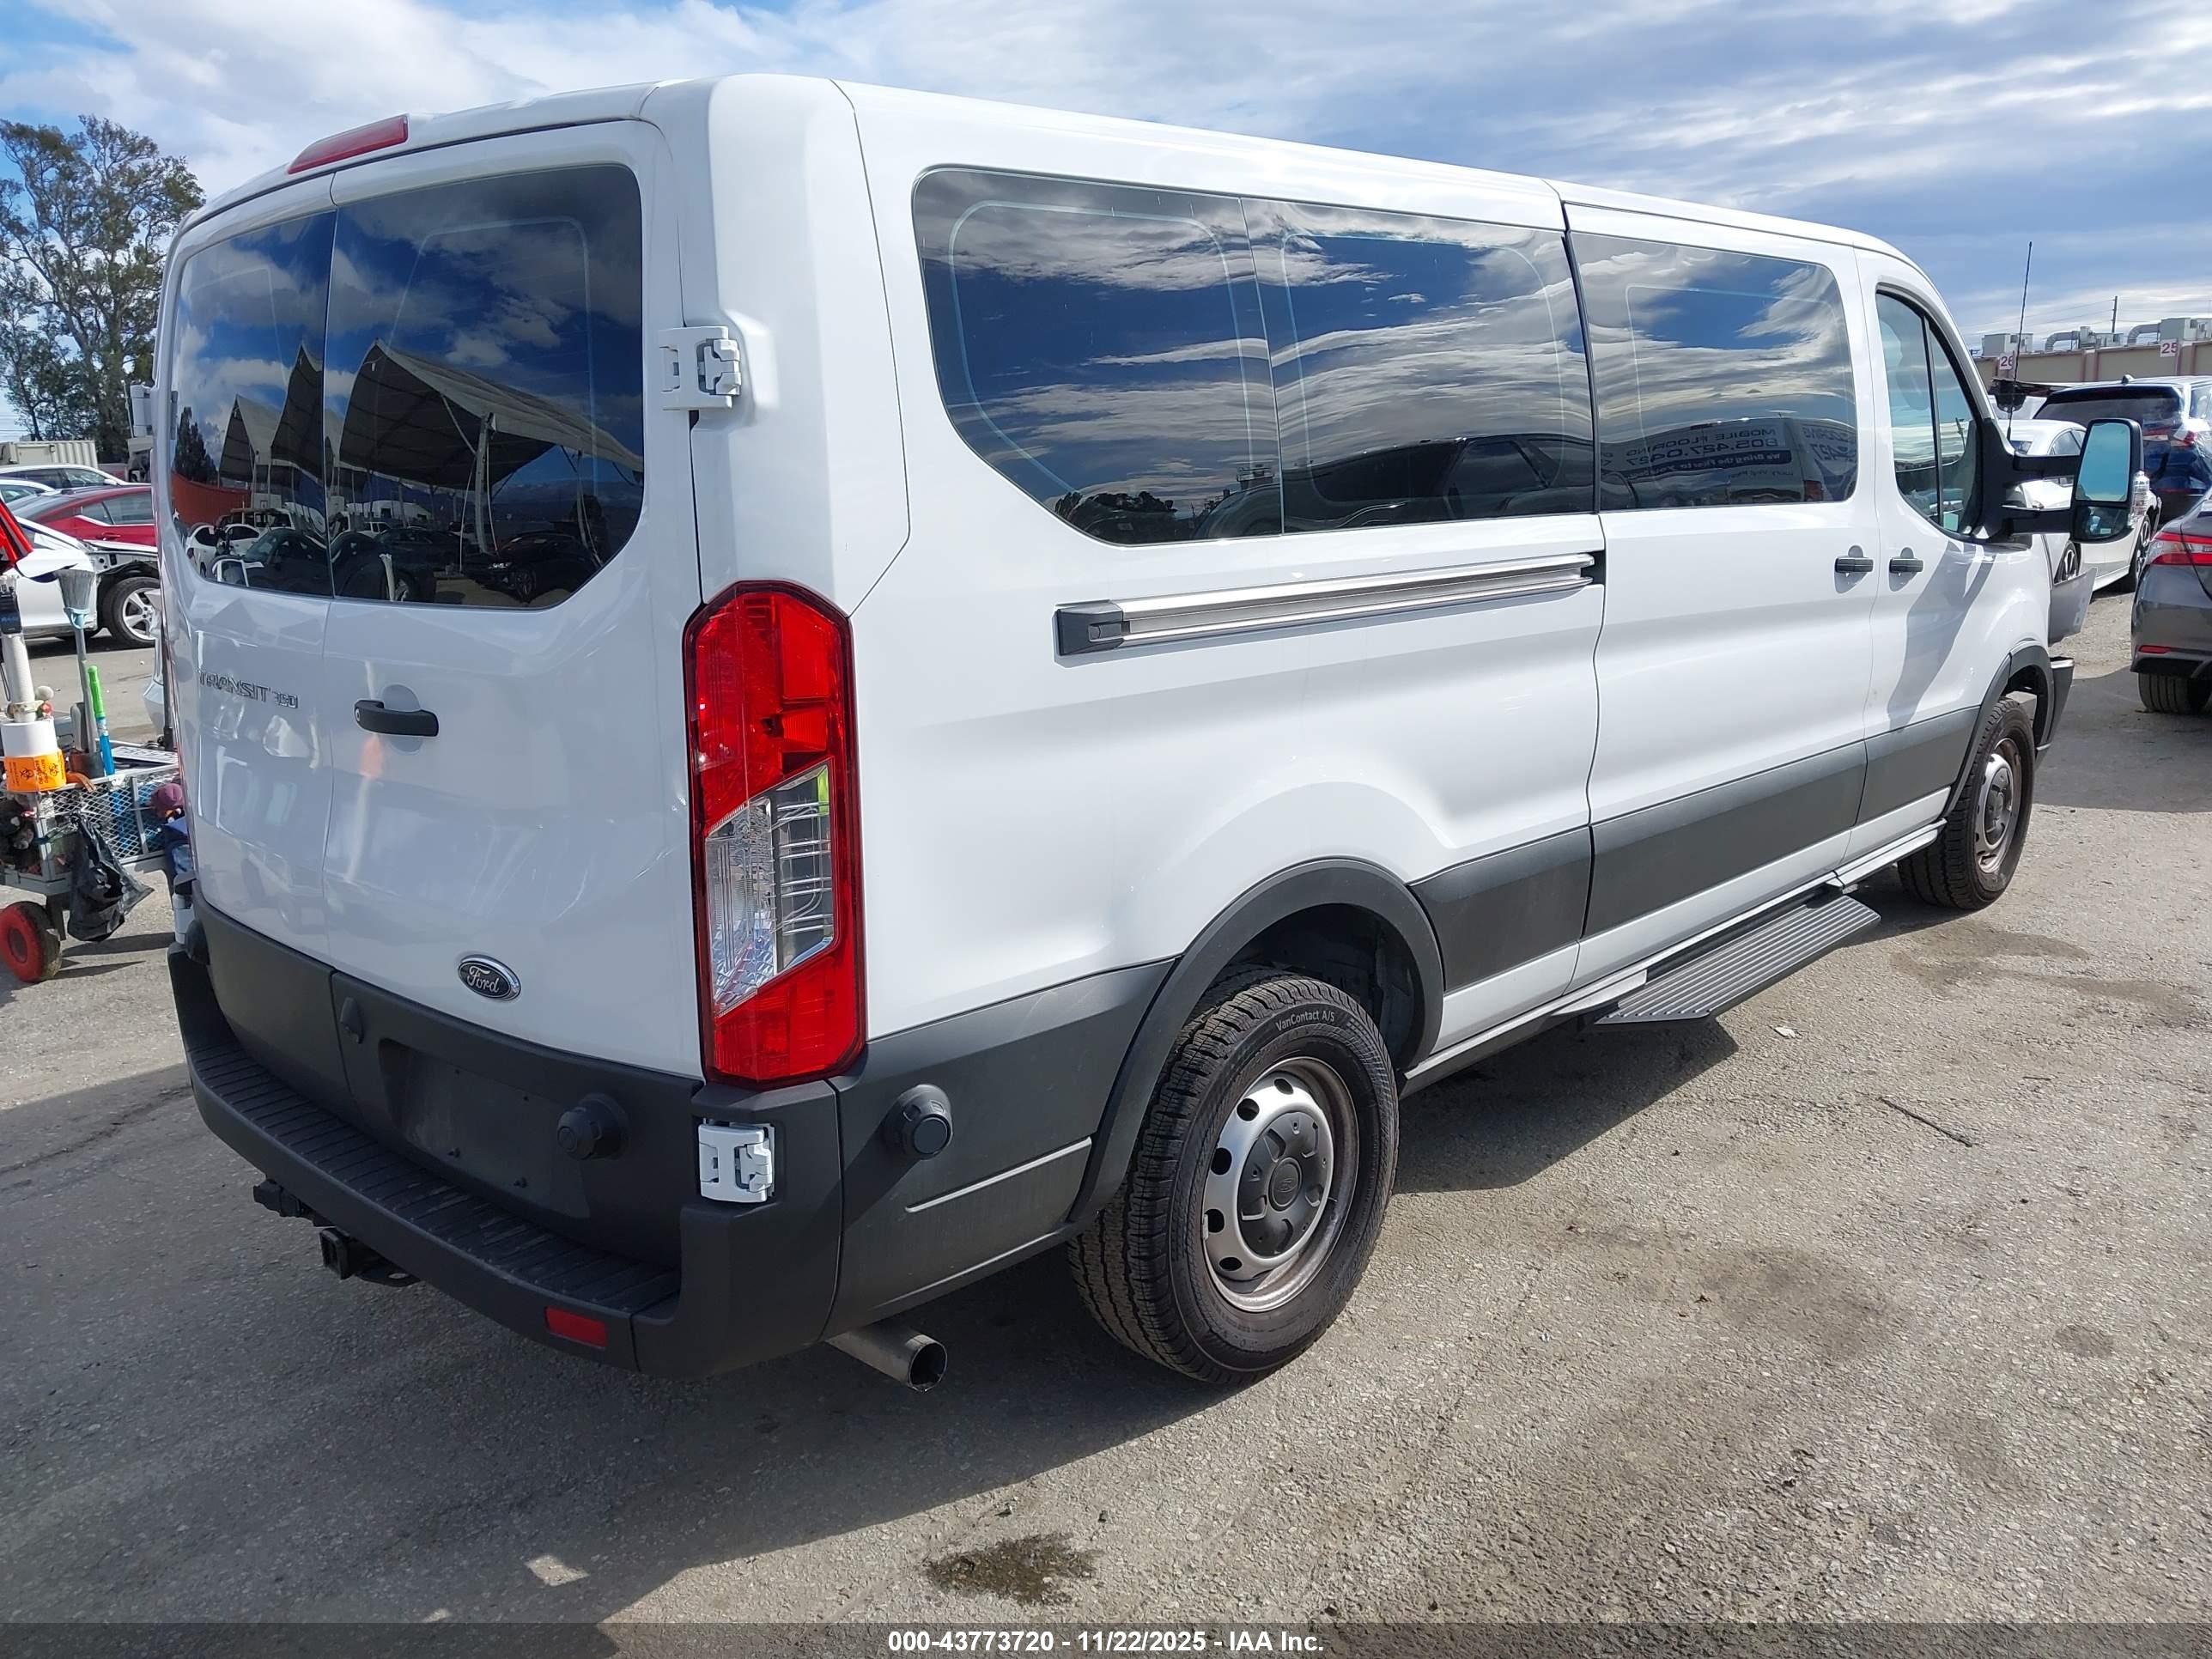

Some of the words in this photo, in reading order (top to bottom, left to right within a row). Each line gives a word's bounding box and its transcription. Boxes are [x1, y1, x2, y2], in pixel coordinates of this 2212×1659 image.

[2161, 342, 2178, 354] 25
[199, 672, 270, 702] TRANSIT
[466, 965, 500, 993] Ford
[1275, 1010, 1320, 1031] VanContact
[1322, 1010, 1335, 1022] A/S
